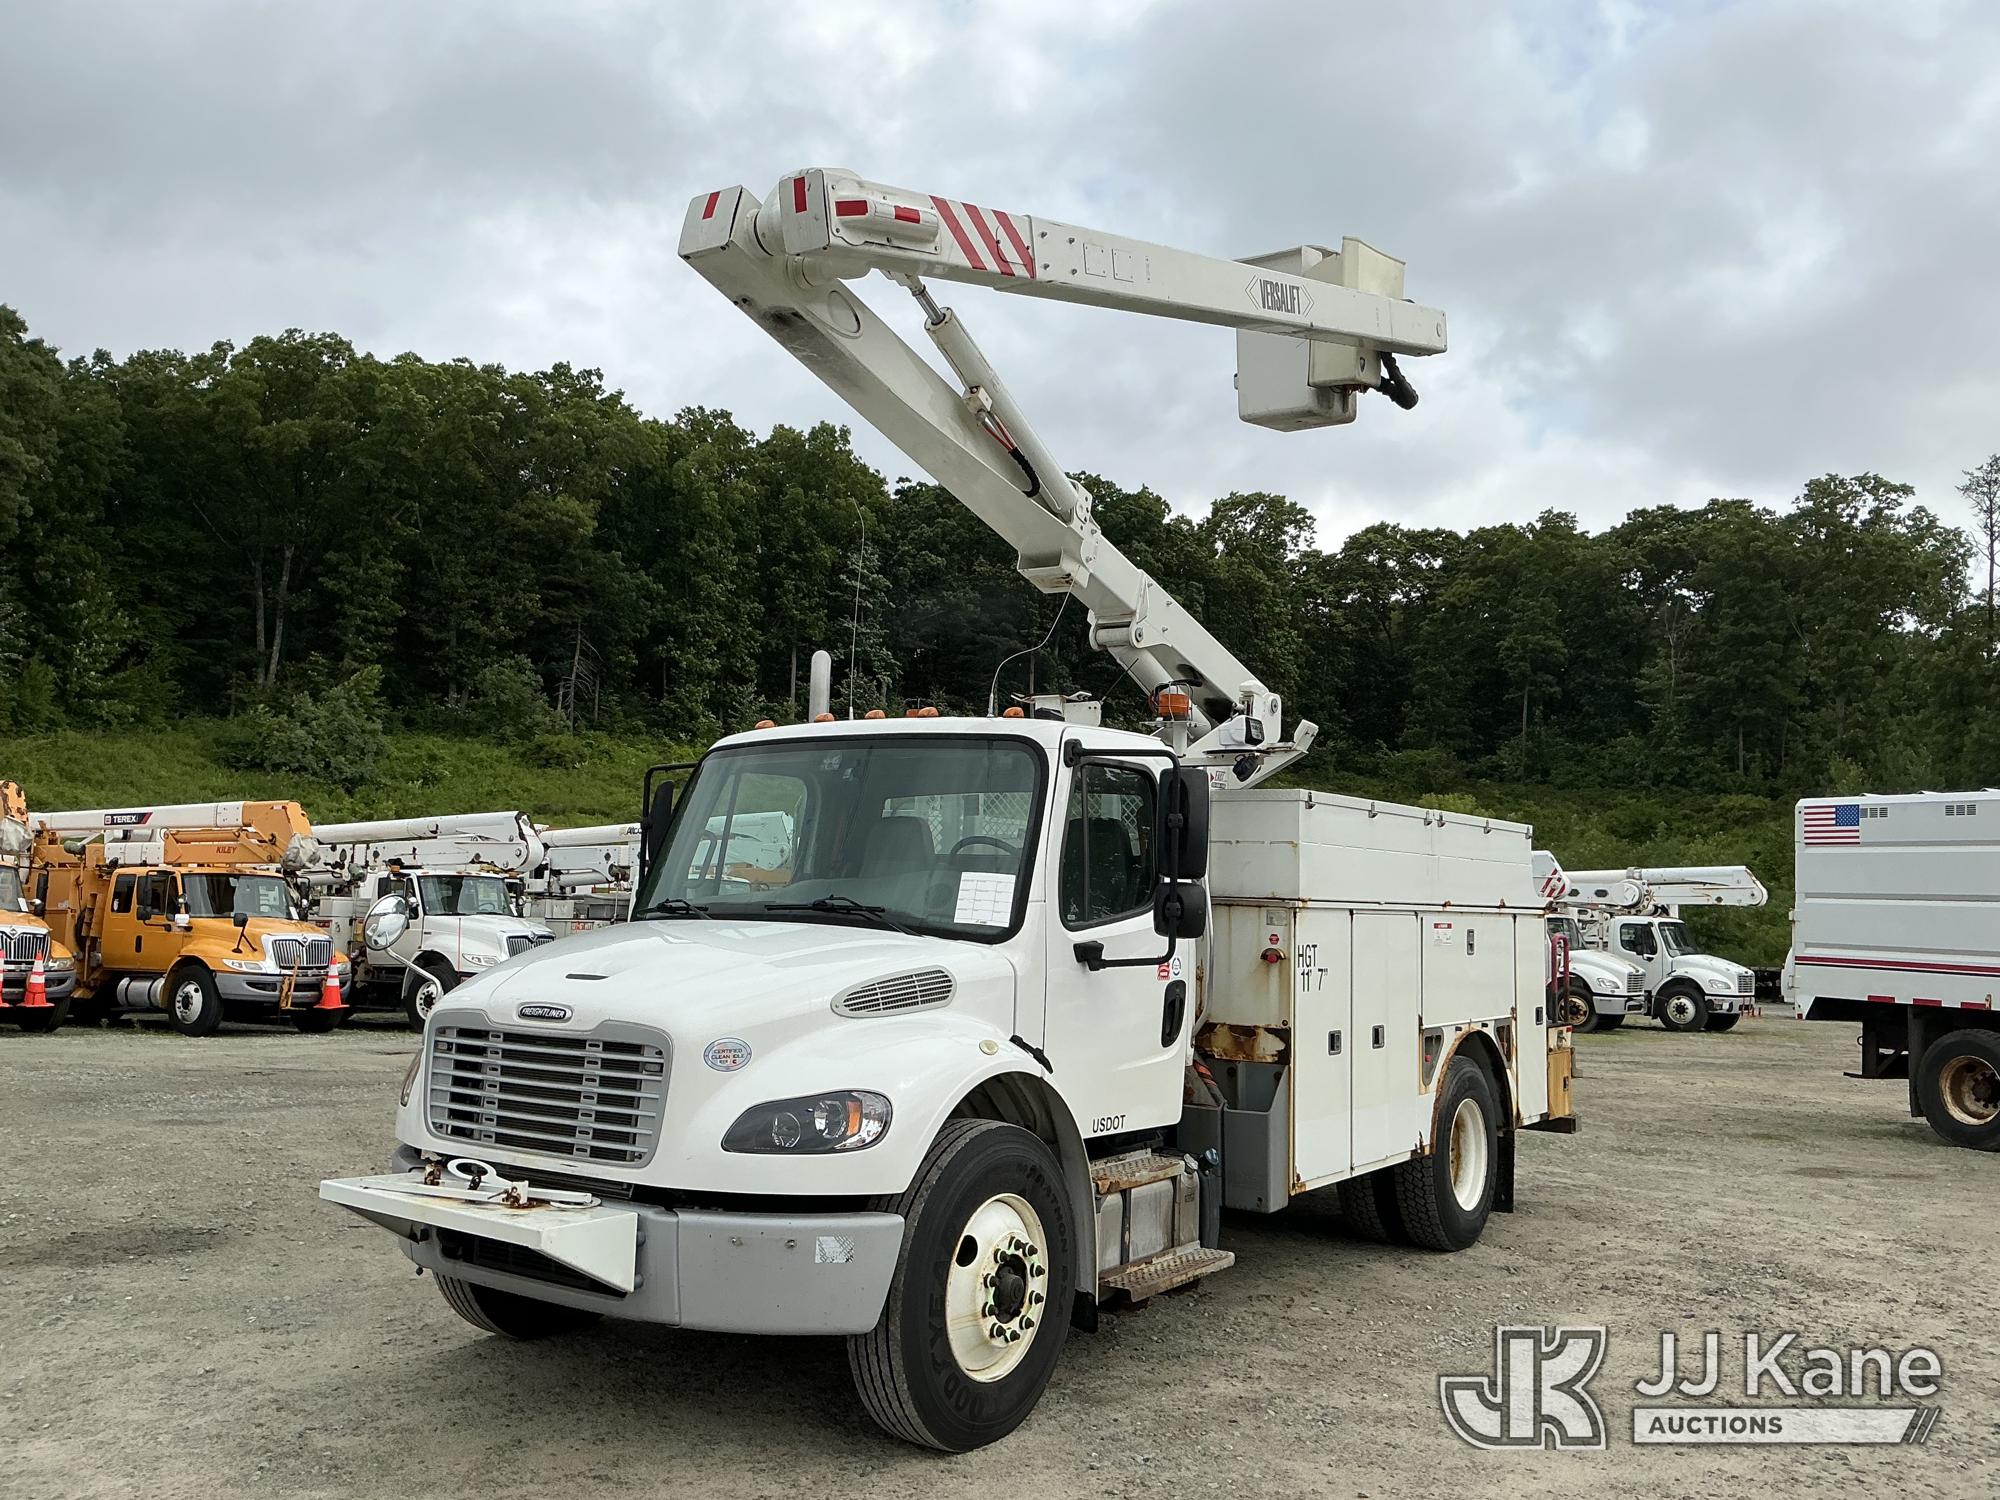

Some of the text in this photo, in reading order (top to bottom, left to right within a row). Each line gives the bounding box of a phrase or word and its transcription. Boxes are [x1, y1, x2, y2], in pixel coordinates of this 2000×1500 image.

[1259, 278, 1301, 315] VERSALIFT
[113, 815, 137, 823] TEREX
[216, 846, 237, 854] KILEY
[1297, 944, 1318, 968] HGT
[521, 1007, 565, 1018] FREIGHTLINER
[1092, 1114, 1126, 1133] USDOT
